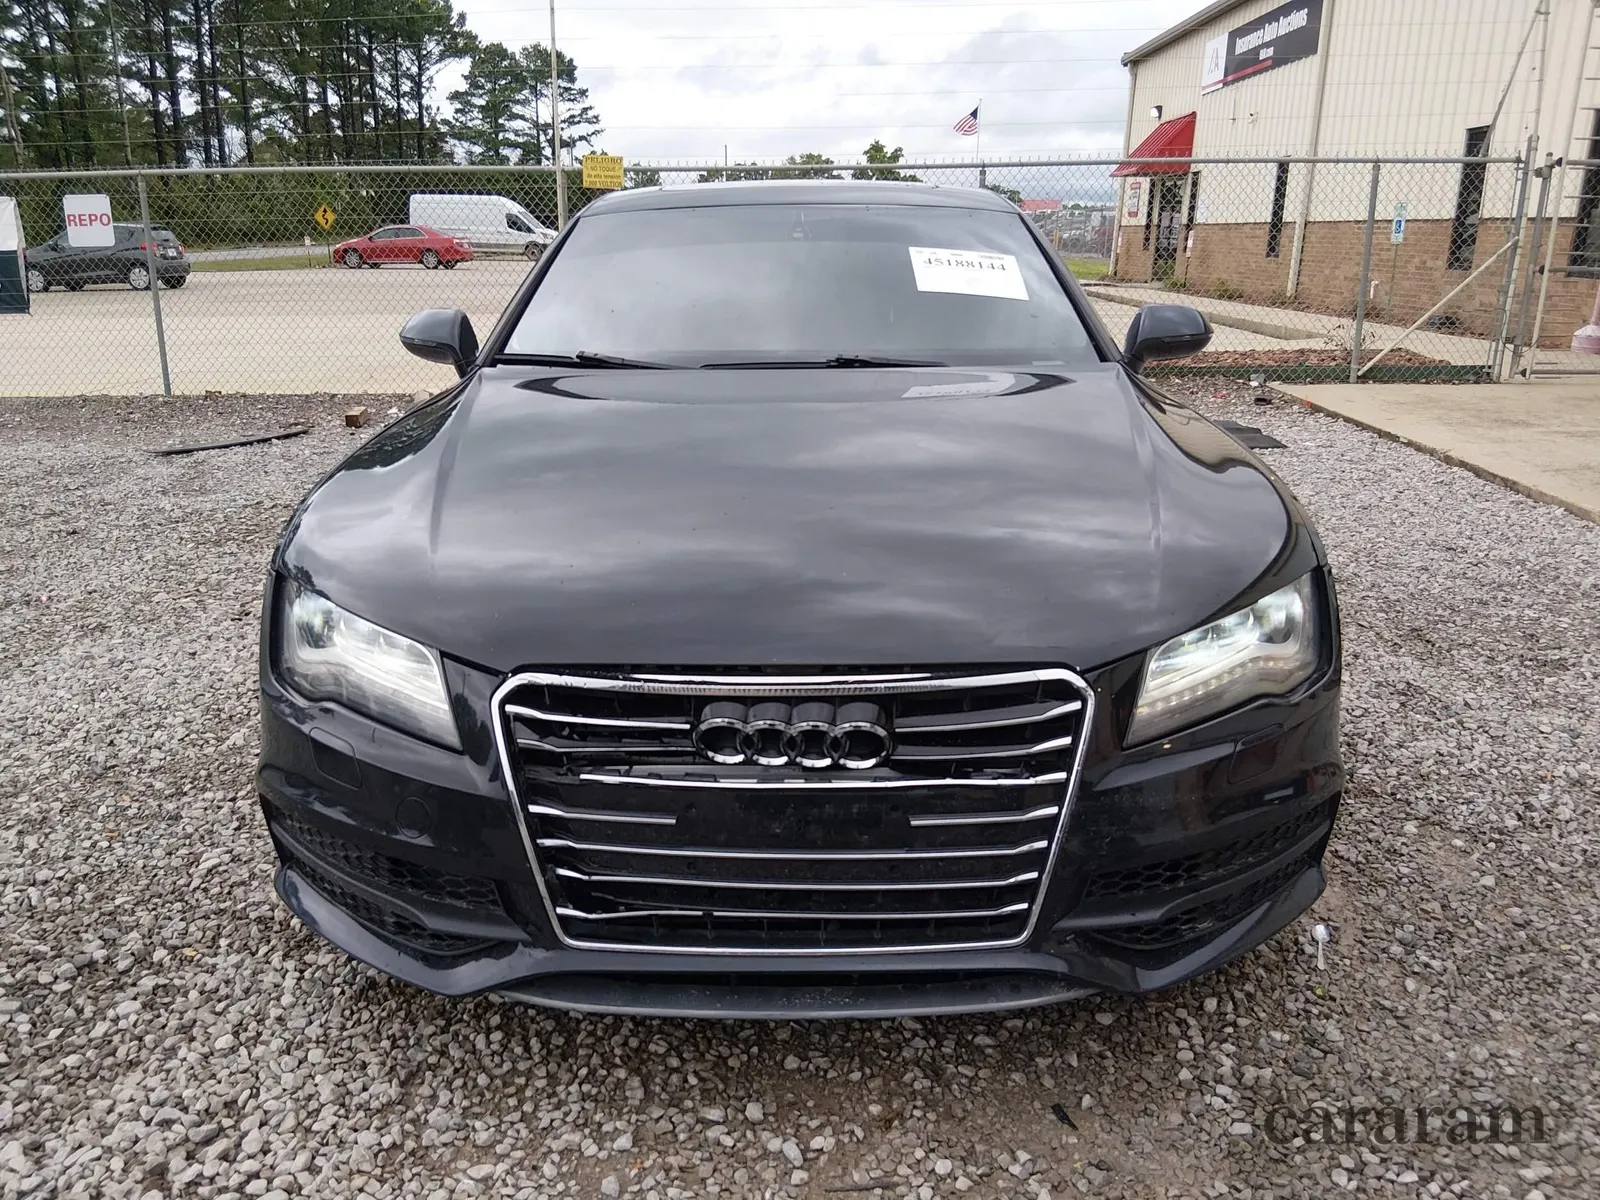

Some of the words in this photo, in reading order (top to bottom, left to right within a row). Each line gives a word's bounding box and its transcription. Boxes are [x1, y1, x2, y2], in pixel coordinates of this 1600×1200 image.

[1235, 28, 1264, 55] Insurance
[1263, 22, 1278, 43] Auto
[1278, 8, 1308, 37] Auctions
[67, 213, 111, 226] REPO
[923, 258, 1006, 271] 45188144
